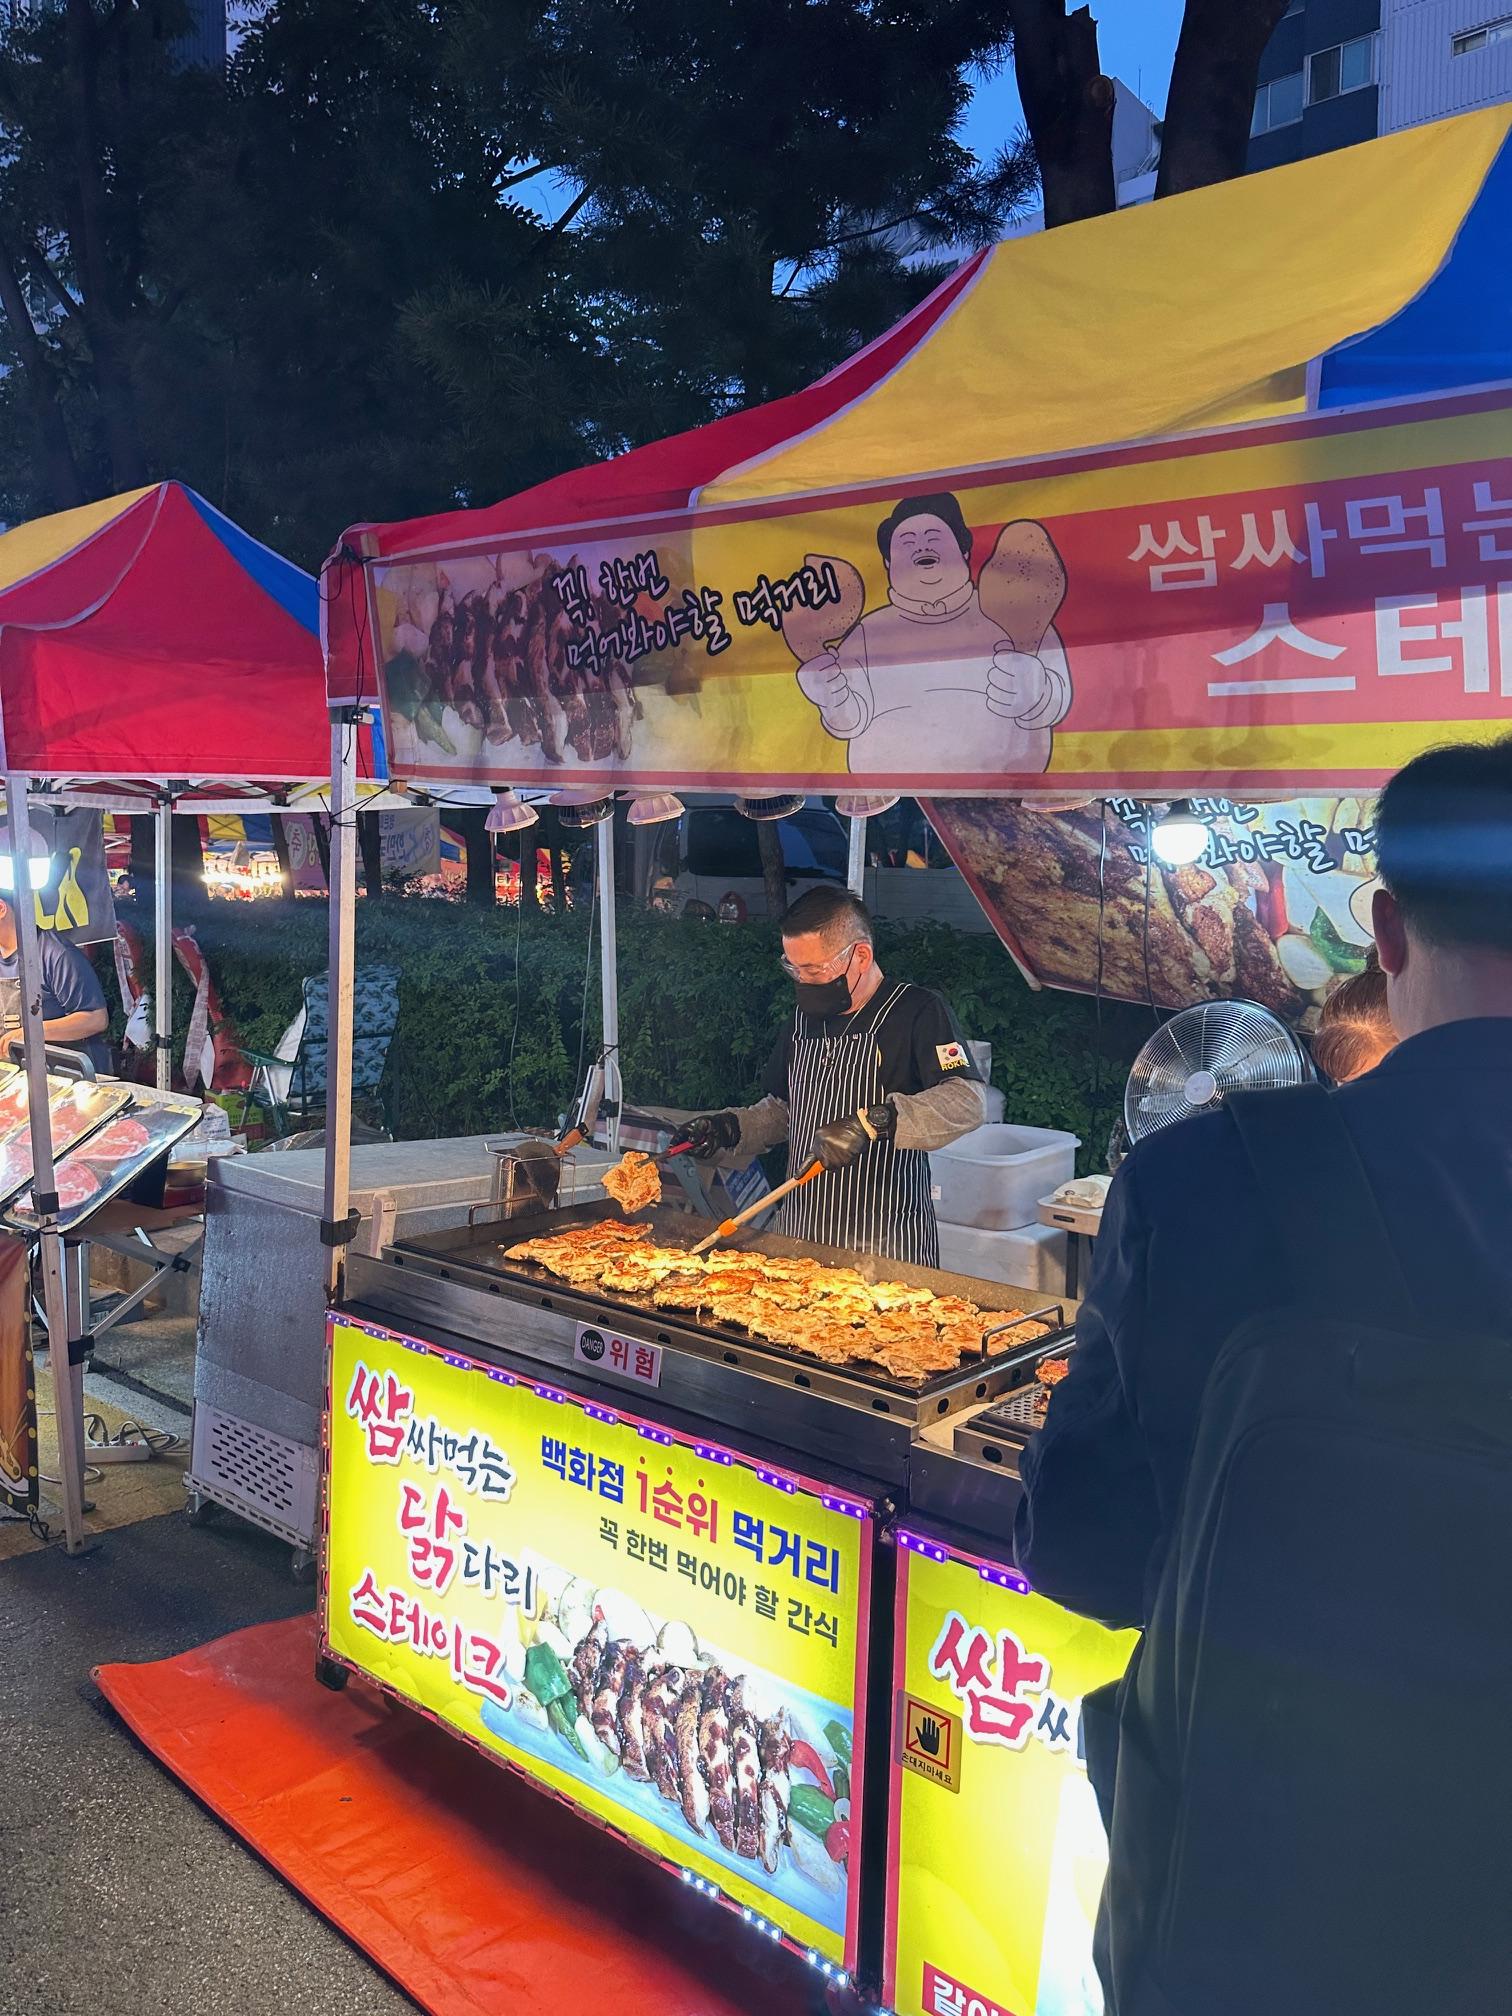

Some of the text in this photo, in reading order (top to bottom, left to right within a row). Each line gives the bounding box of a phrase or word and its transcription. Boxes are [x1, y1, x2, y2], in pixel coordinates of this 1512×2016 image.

[600, 553, 667, 605] 한번
[735, 562, 841, 630] 먹거리
[581, 1336, 604, 1355] DANGER
[349, 1366, 512, 1494] 쌈싸먹는
[401, 1485, 532, 1611] 닭다리
[541, 1434, 840, 1595] 백화점 1순위 먹거리
[352, 1572, 508, 1702] 스테이크
[599, 1516, 839, 1649] 꼭 한번 먹어야 할 간식
[901, 1752, 953, 1786] 손대지마세요
